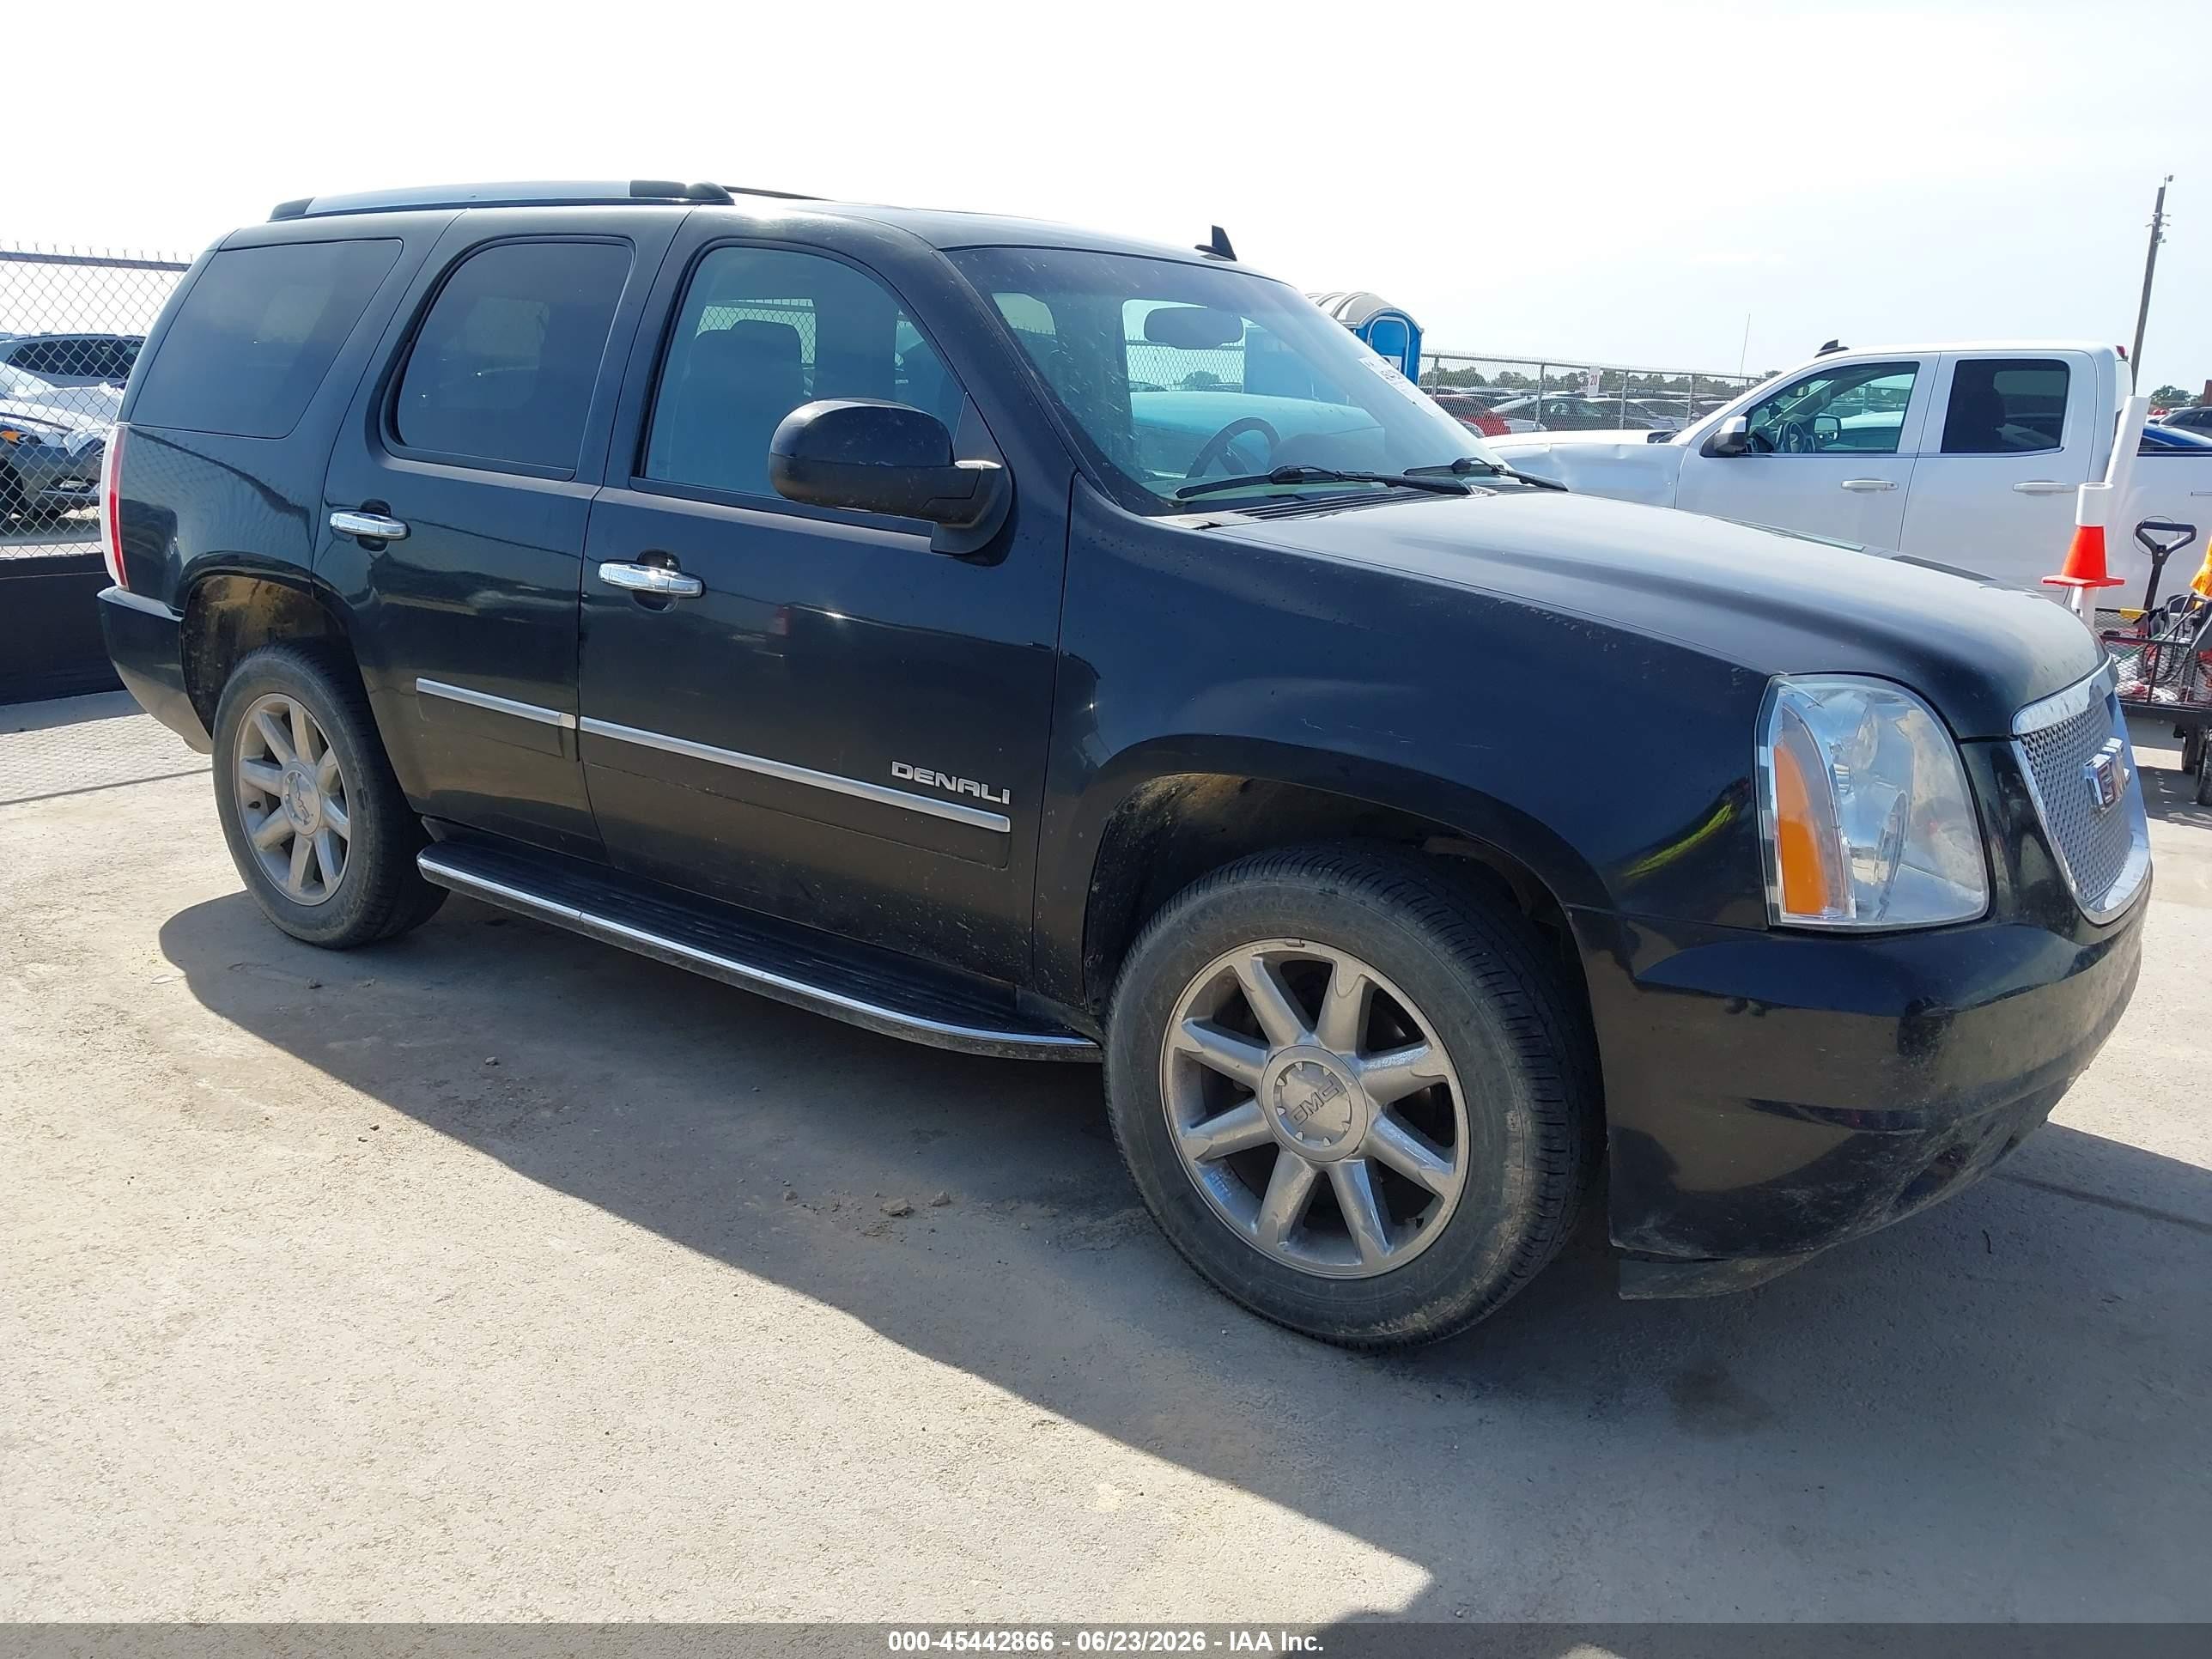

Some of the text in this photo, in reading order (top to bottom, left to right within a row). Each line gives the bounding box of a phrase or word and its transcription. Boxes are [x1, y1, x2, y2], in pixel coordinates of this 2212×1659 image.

[1590, 374, 1598, 386] 20
[891, 761, 1011, 805] DENALI
[1289, 1079, 1340, 1127] GMC
